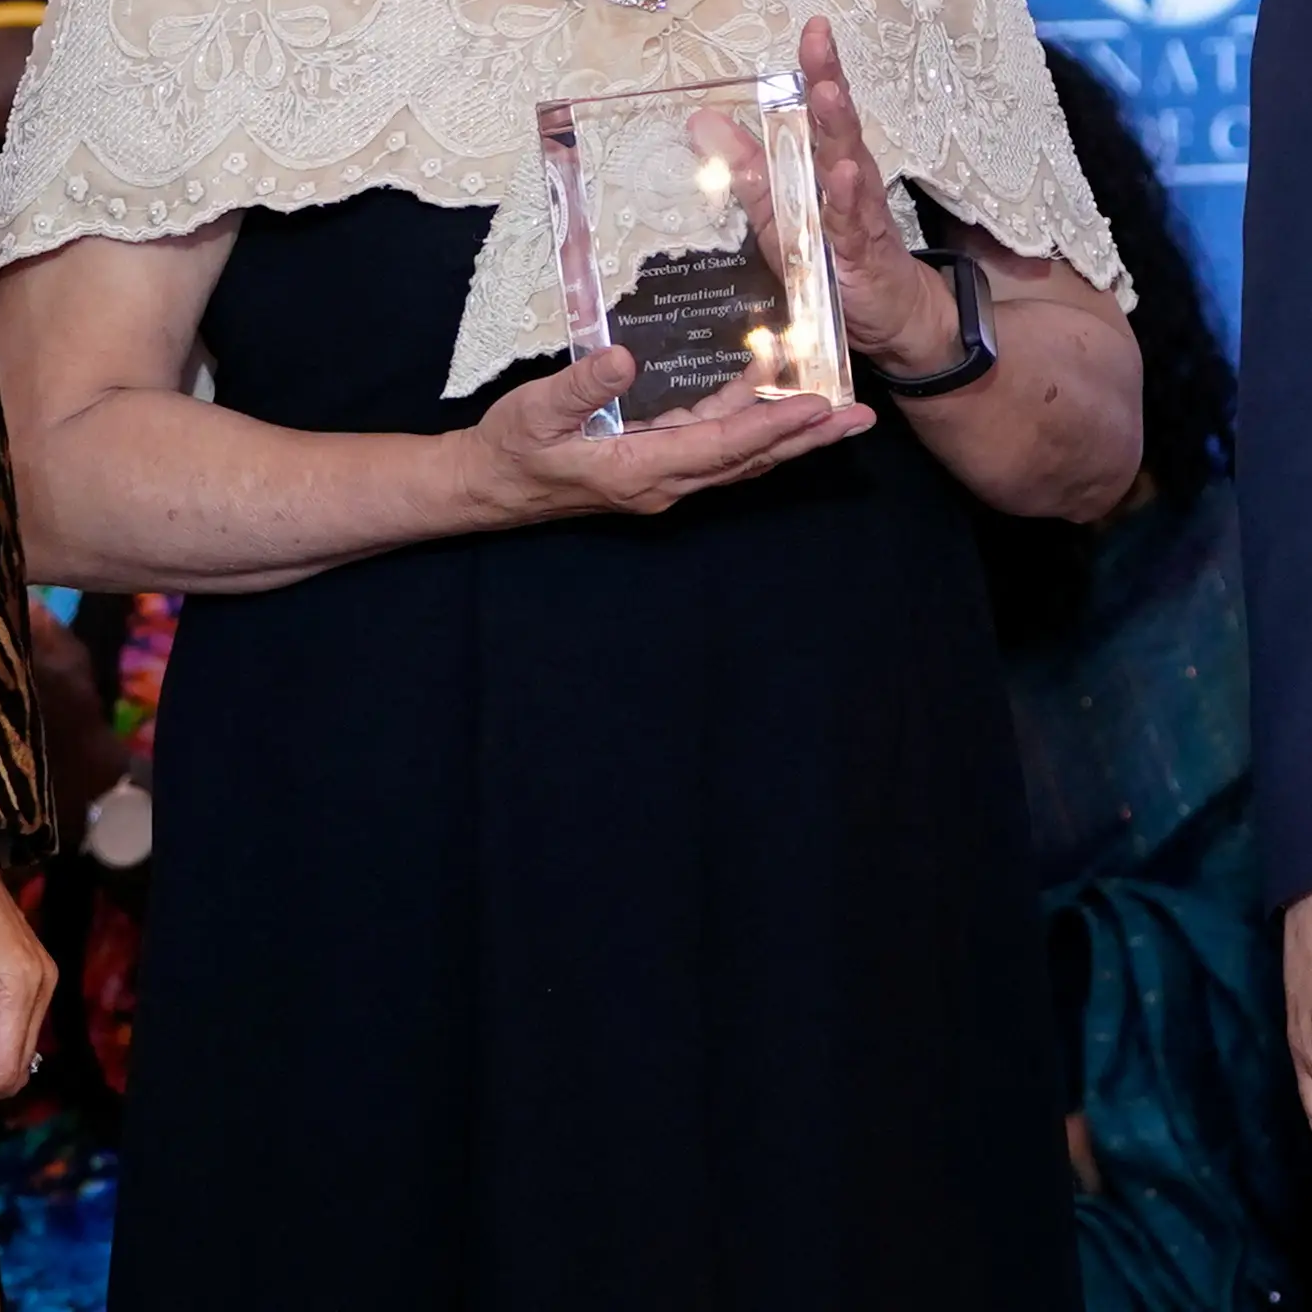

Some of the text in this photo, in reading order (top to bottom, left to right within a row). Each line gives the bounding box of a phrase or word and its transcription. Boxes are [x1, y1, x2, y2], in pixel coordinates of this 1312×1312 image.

[693, 258, 706, 271] of
[708, 255, 747, 268] State's
[654, 285, 735, 306] International
[617, 296, 775, 327] Women of Courage Award
[687, 328, 713, 340] 2025
[644, 356, 713, 374] Angelique
[670, 370, 744, 389] Philippines
